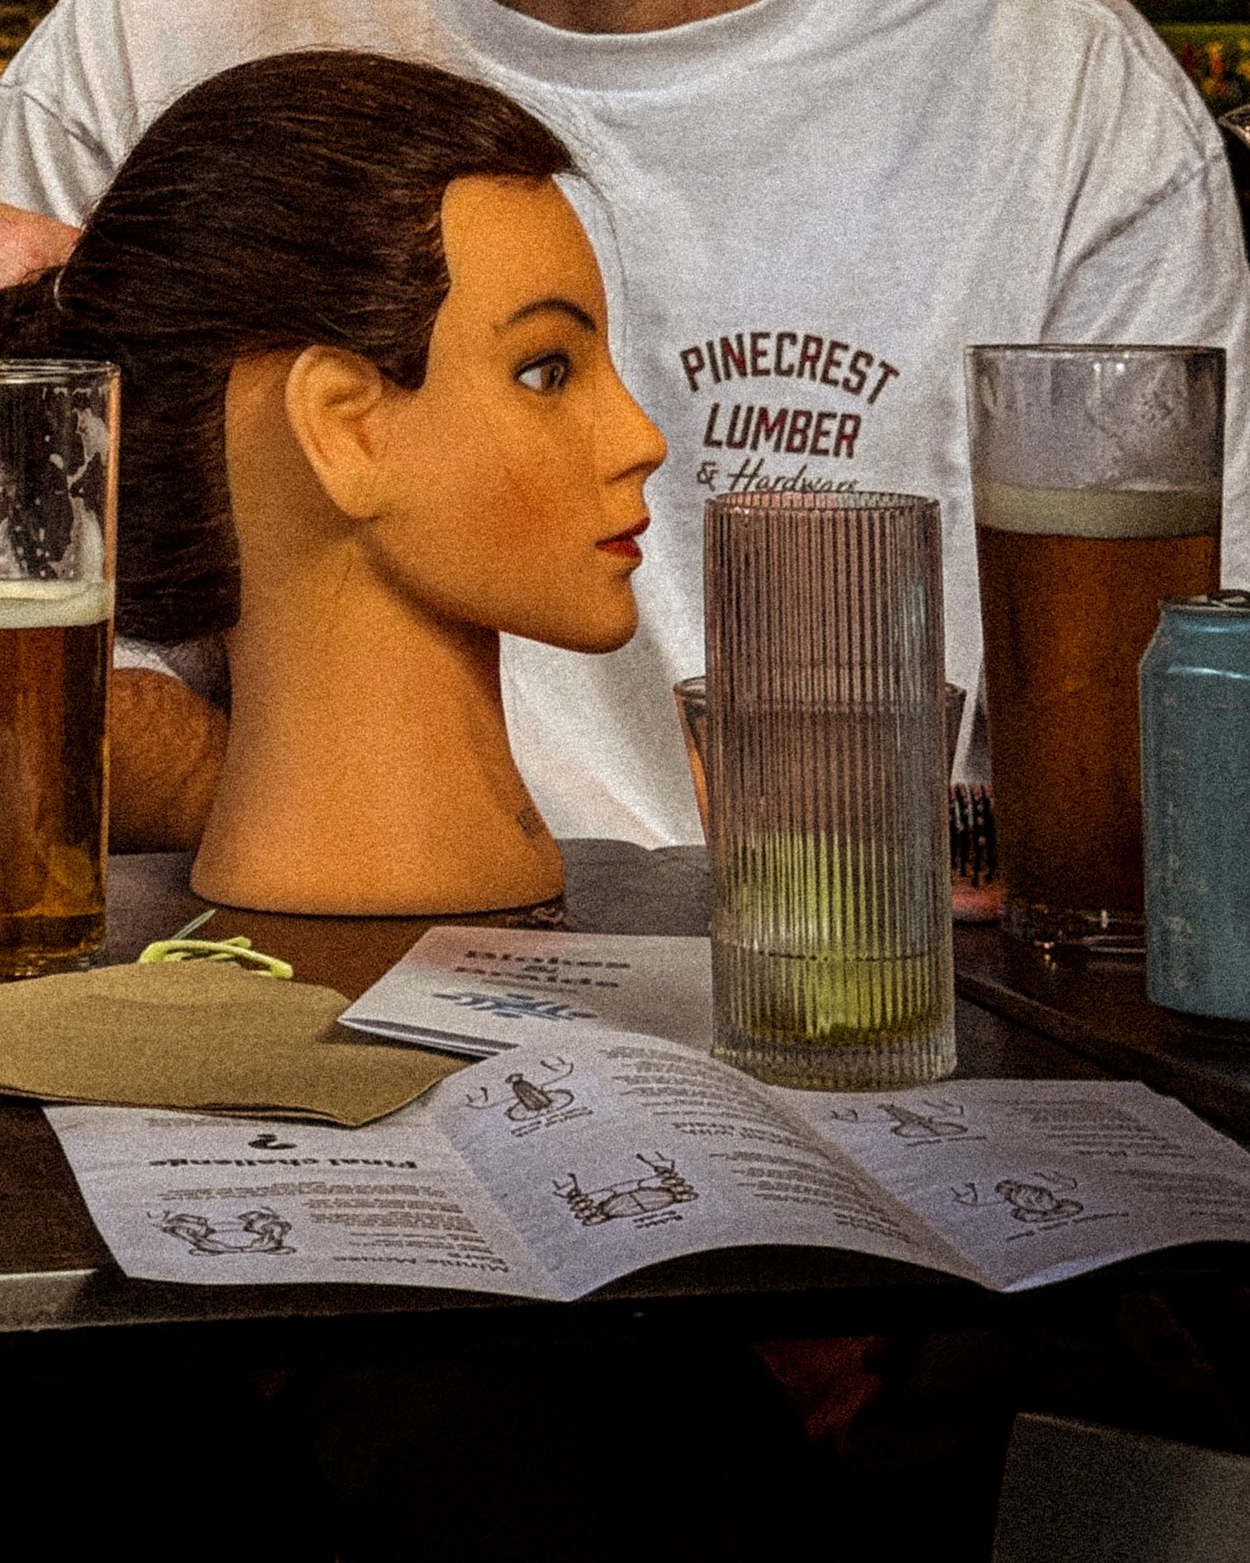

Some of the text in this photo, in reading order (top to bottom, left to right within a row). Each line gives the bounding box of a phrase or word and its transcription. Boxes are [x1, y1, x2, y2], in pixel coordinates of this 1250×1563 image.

[680, 331, 900, 405] PINECREST
[703, 402, 862, 458] LUMBER
[697, 461, 719, 491] &
[149, 1157, 418, 1169] Final challenge
